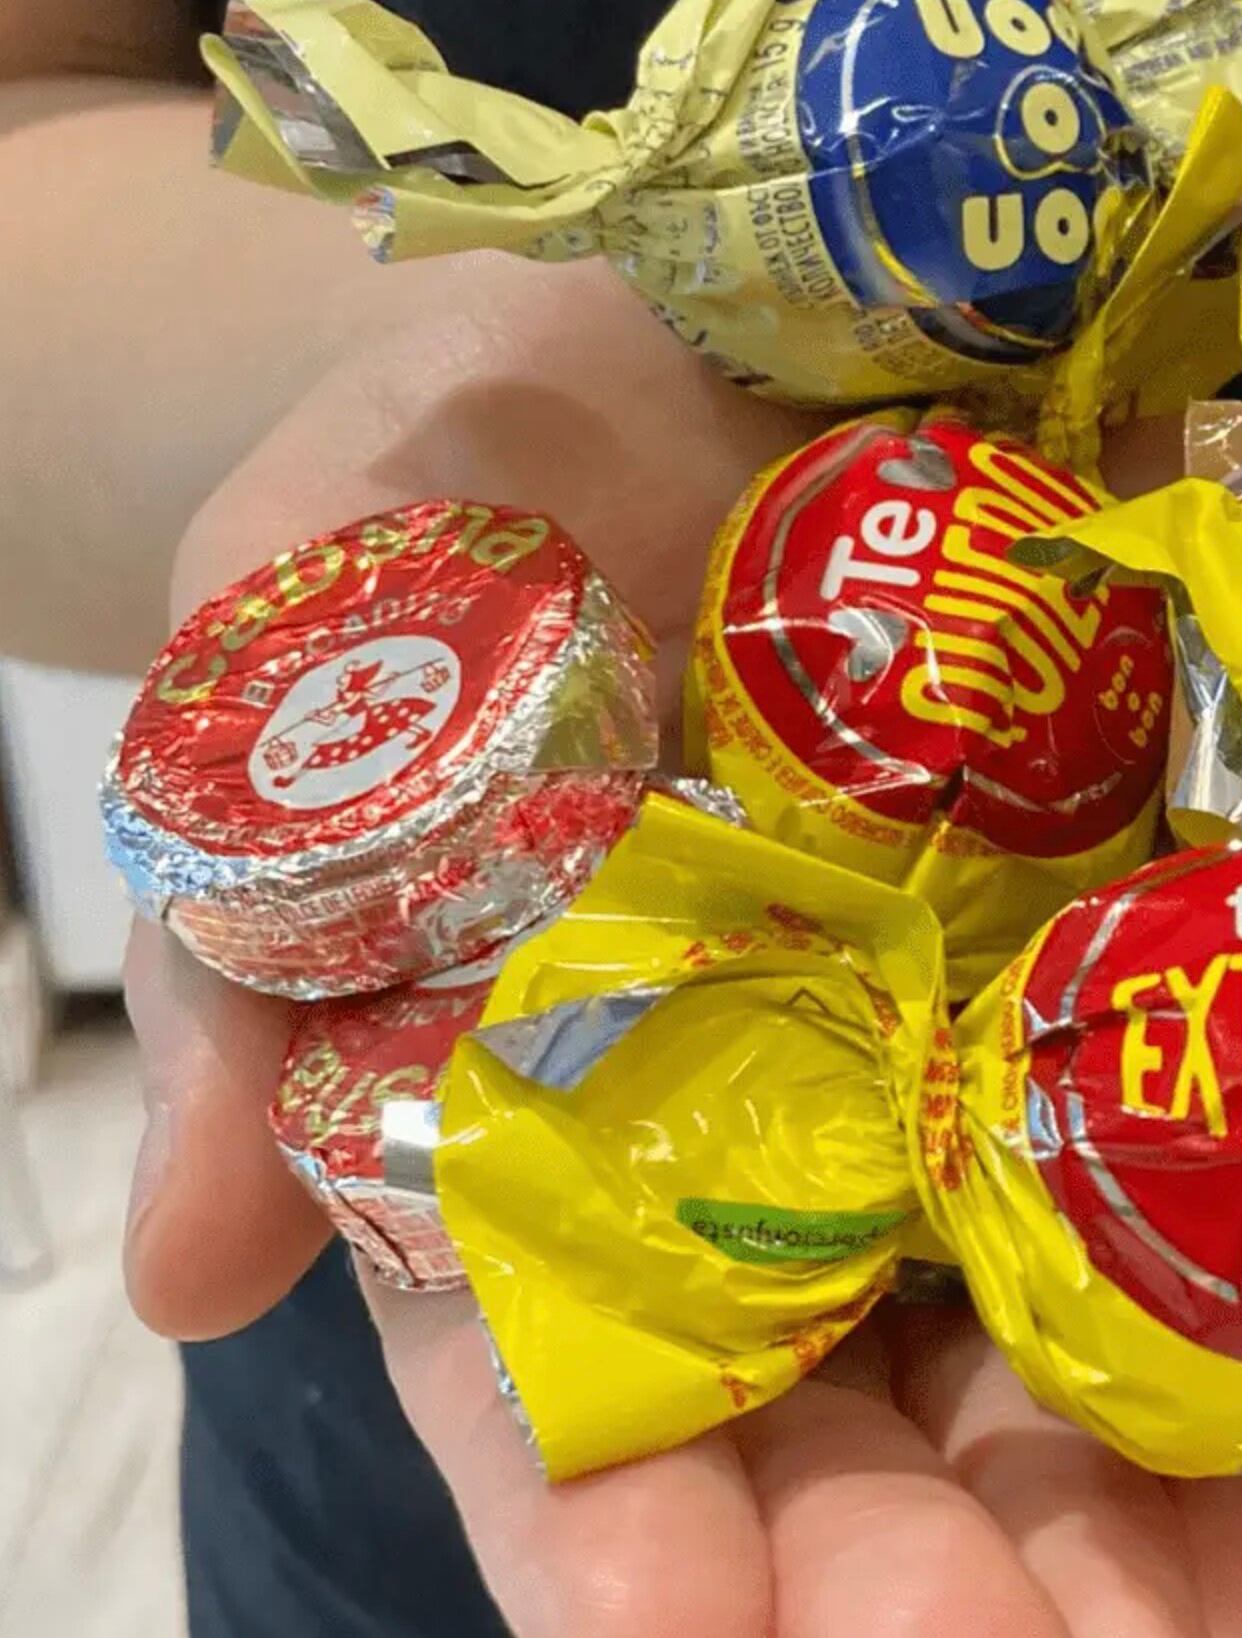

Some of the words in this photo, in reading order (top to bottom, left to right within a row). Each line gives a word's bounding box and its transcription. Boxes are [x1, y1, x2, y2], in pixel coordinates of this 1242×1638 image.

[961, 185, 1098, 272] on
[820, 500, 937, 600] Te
[1097, 654, 1135, 711] bon
[1129, 691, 1163, 749] bon
